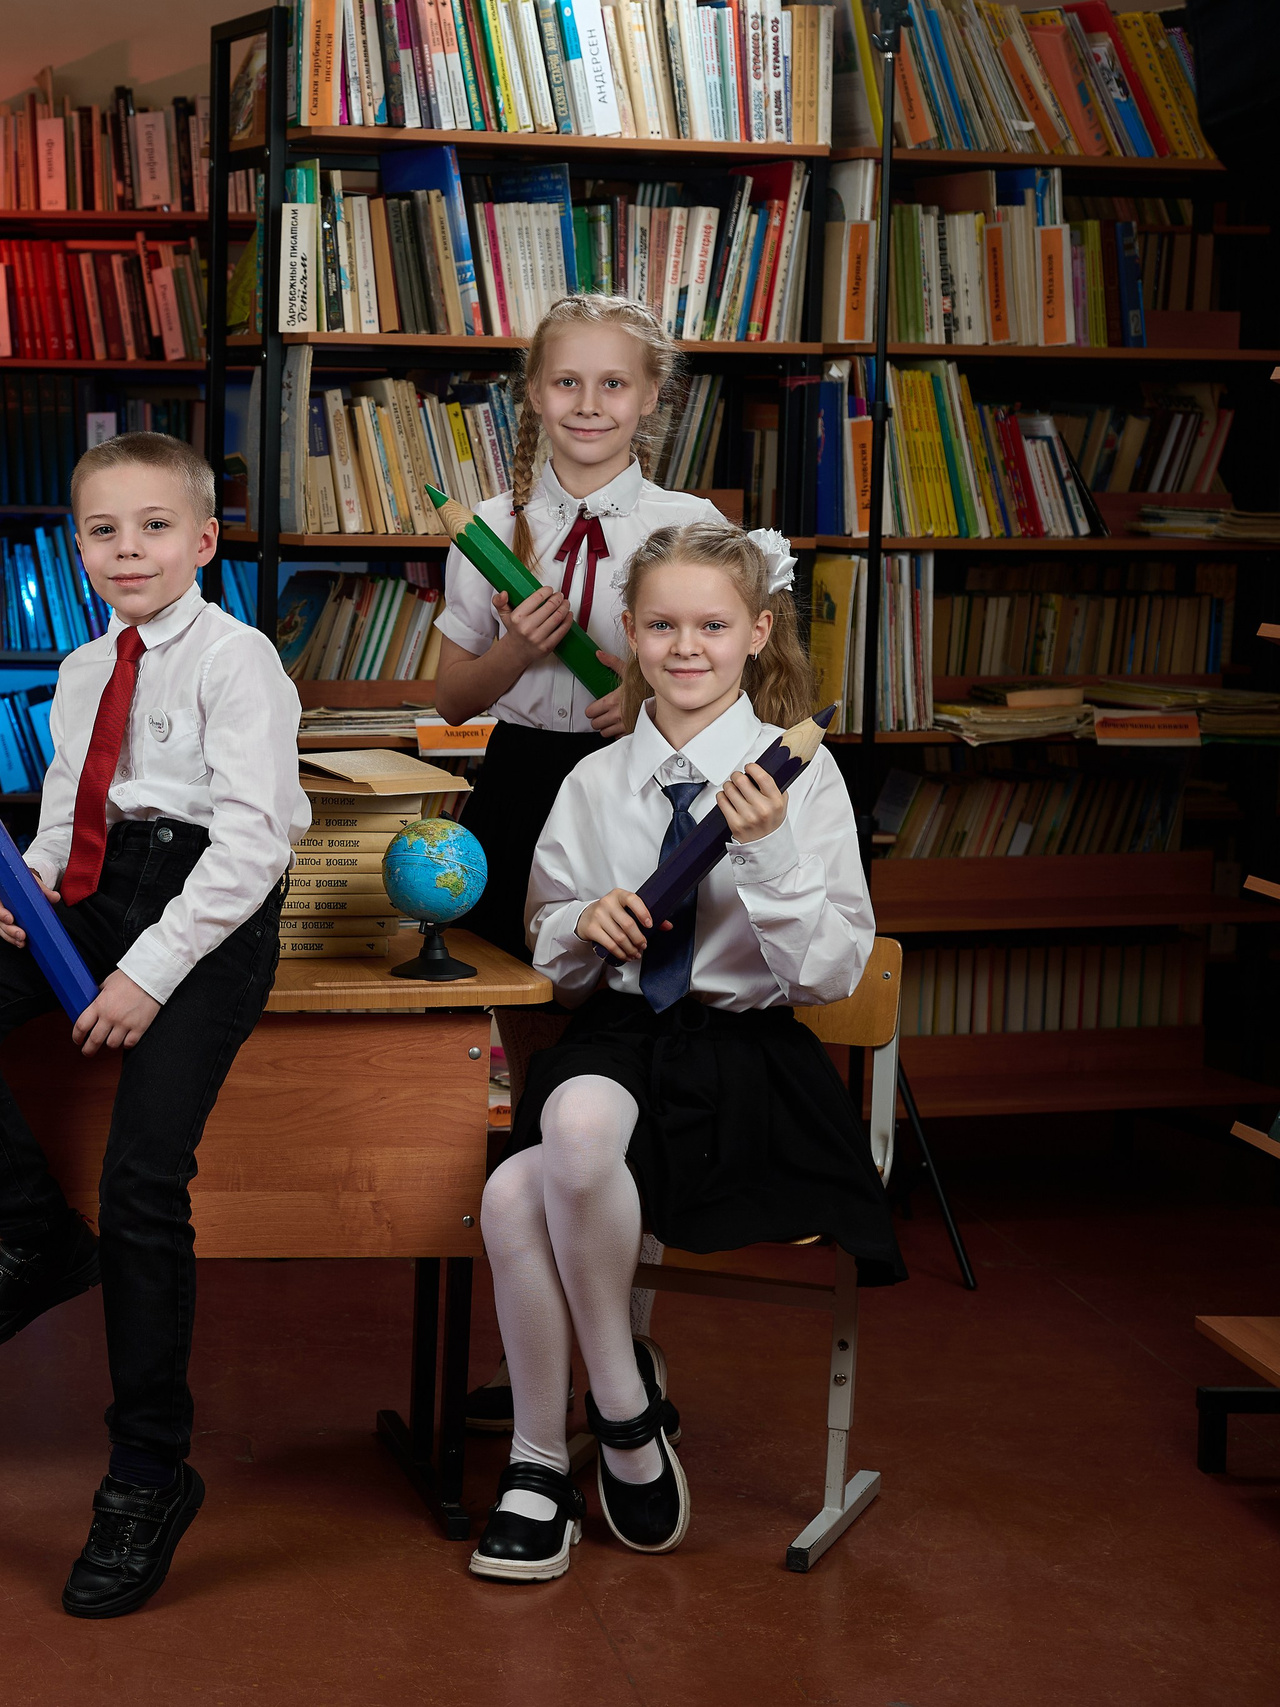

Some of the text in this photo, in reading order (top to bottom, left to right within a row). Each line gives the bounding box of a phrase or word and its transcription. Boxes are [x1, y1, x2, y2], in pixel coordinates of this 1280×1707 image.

[309, 19, 324, 116] Сказки зарубежных
[323, 32, 334, 82] писателей
[586, 28, 609, 104] АНДЕРСЕН
[771, 36, 780, 78] СТРАНА
[899, 74, 916, 120] Сборники
[46, 138, 56, 182] Физика
[144, 123, 157, 182] География
[287, 208, 298, 326] ЗАРУБЕЖНЫЕ ПИСАТЕЛИ
[851, 252, 862, 310] С. Маршак
[990, 246, 1001, 308] Маяковский
[1045, 254, 1055, 318] С. Михалков
[860, 442, 869, 496] Чуковский
[443, 728, 488, 739] Андерсен Г.
[320, 797, 355, 805] ЖИВОЙ
[324, 818, 358, 827] ЖИВОЙ
[294, 839, 360, 848] ЖИВОЙ РОДН
[295, 858, 358, 866] ЖИВОЙ РОДН
[315, 879, 348, 888] ЖИВОЙ
[301, 920, 334, 929] ЖИВОЙ
[314, 901, 348, 910] ЖИВОЙ
[376, 921, 386, 929] 4
[290, 942, 323, 951] ЖИВОЙ
